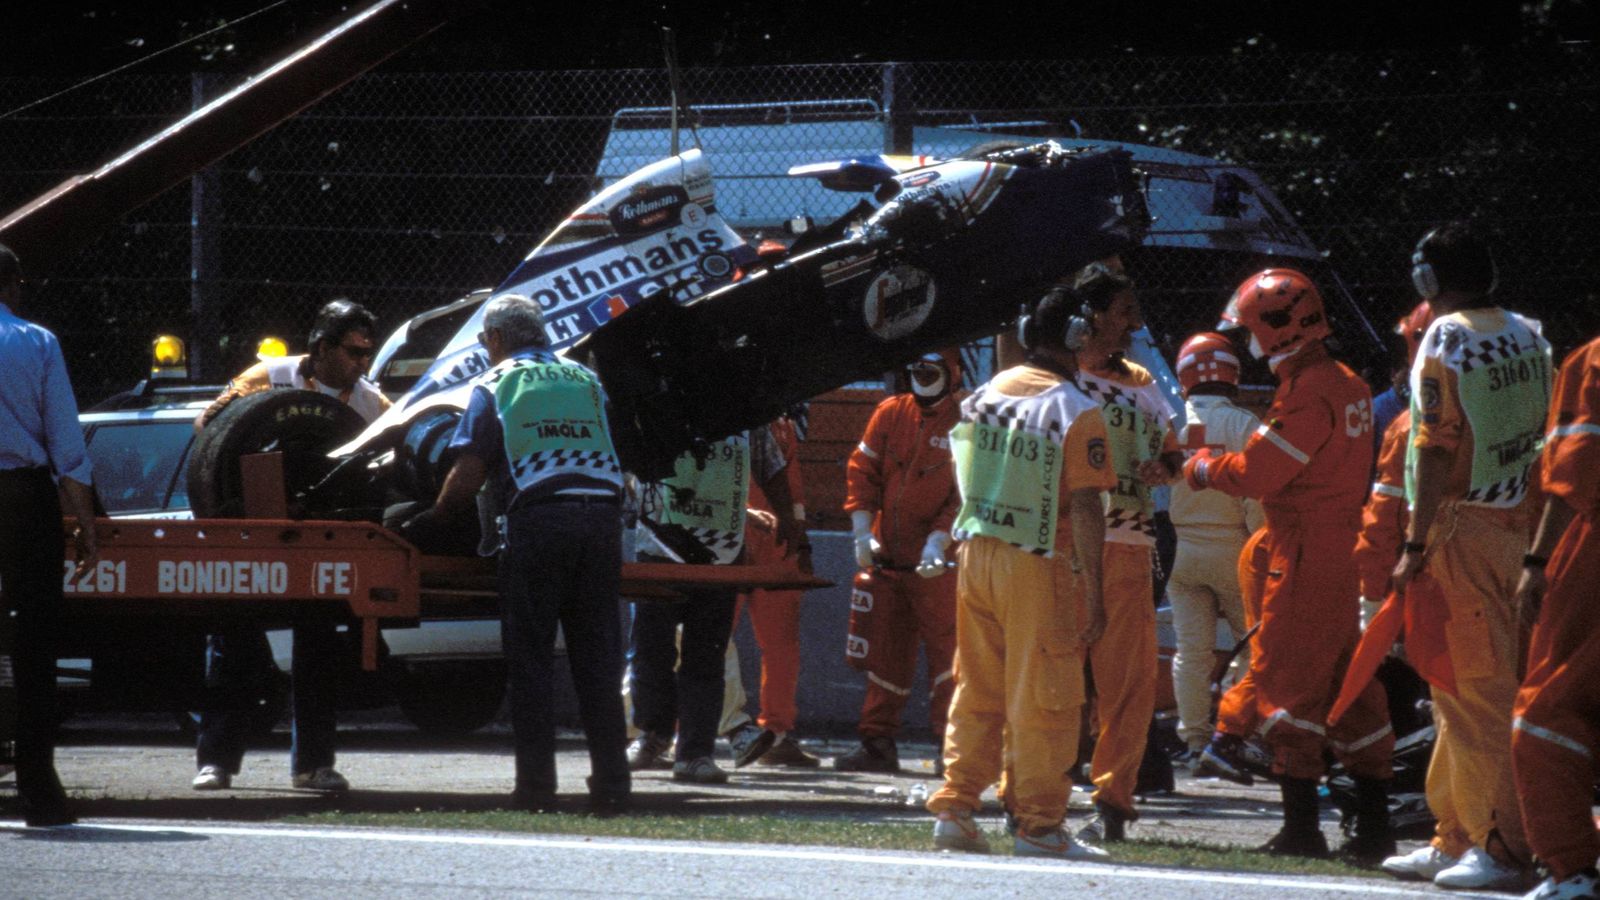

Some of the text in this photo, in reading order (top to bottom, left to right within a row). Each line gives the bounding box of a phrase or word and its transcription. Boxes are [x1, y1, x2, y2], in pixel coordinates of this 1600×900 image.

[530, 228, 723, 313] othmans
[536, 423, 593, 439] IMOLA
[158, 561, 288, 594] BONDENO
[311, 561, 358, 596] (FE)
